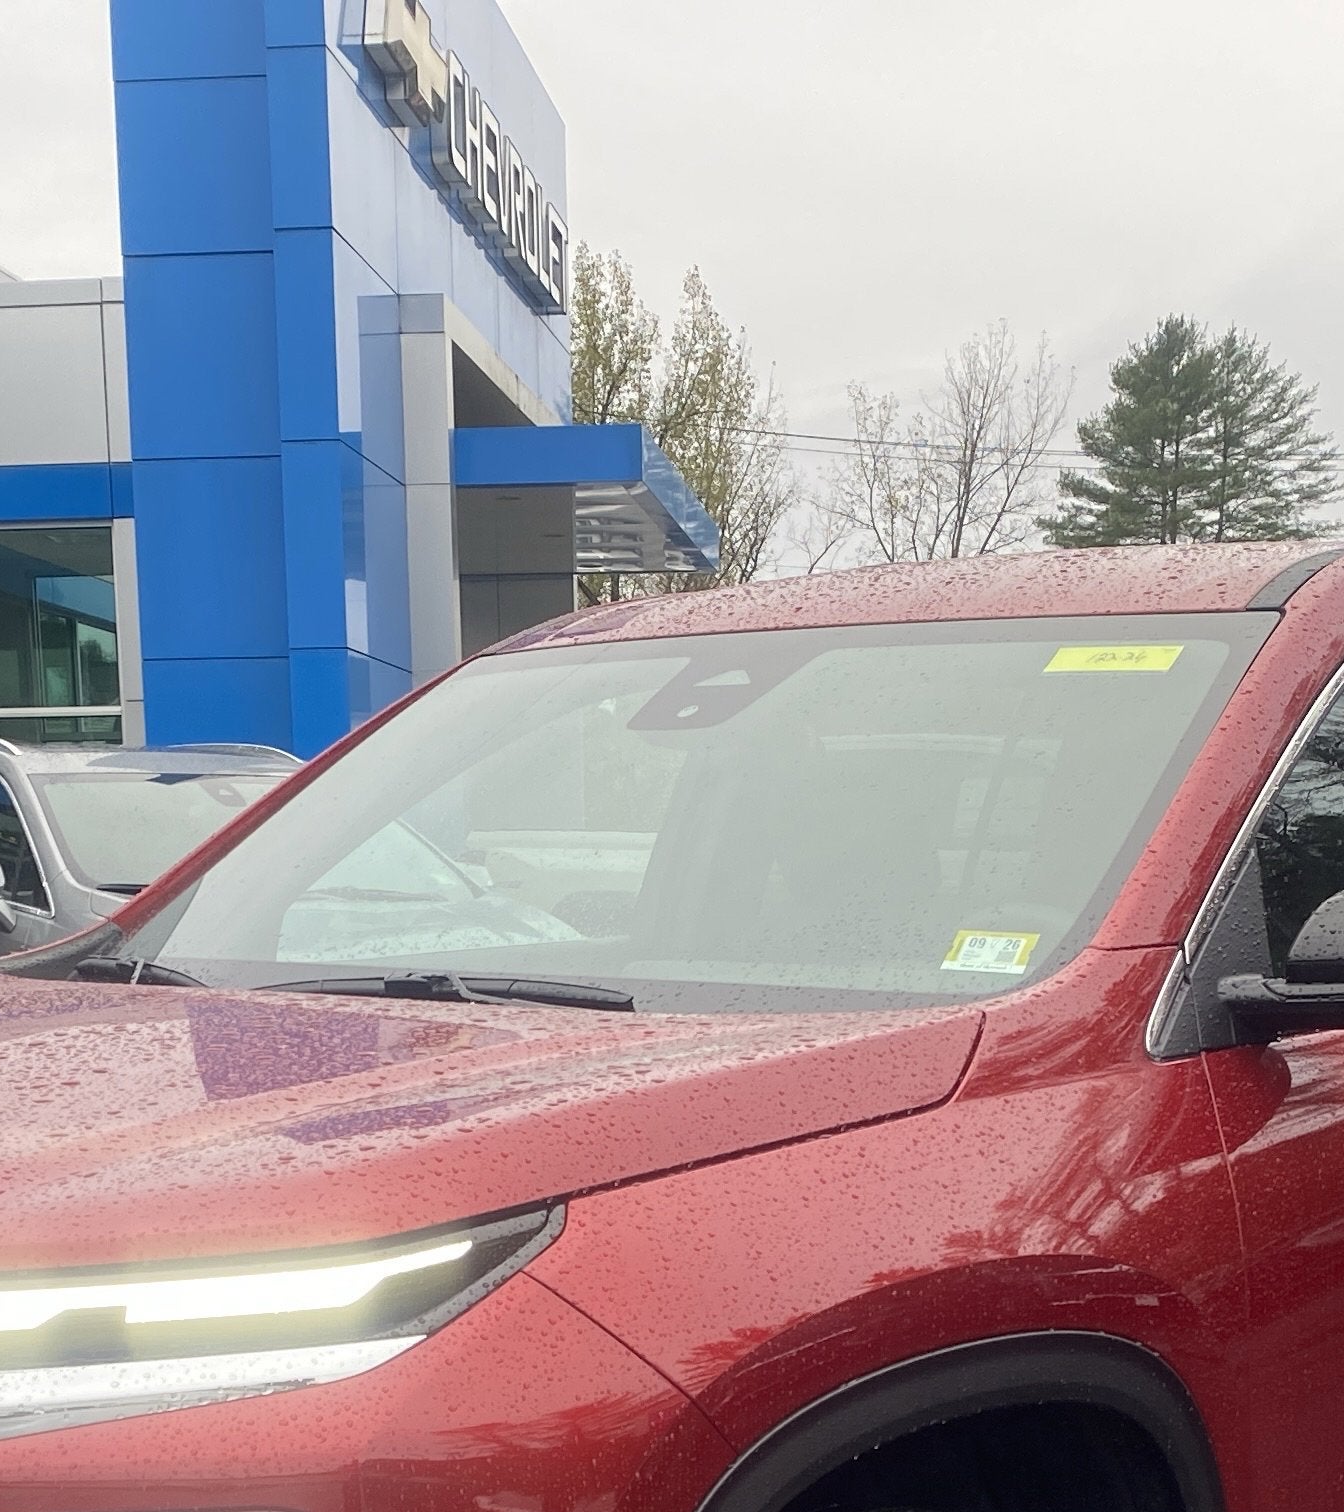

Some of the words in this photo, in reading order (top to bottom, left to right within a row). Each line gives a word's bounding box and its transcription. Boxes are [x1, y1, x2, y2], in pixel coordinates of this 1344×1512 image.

[446, 49, 568, 314] CHEVROLET
[968, 937, 986, 949] 09
[1002, 939, 1021, 951] 26
